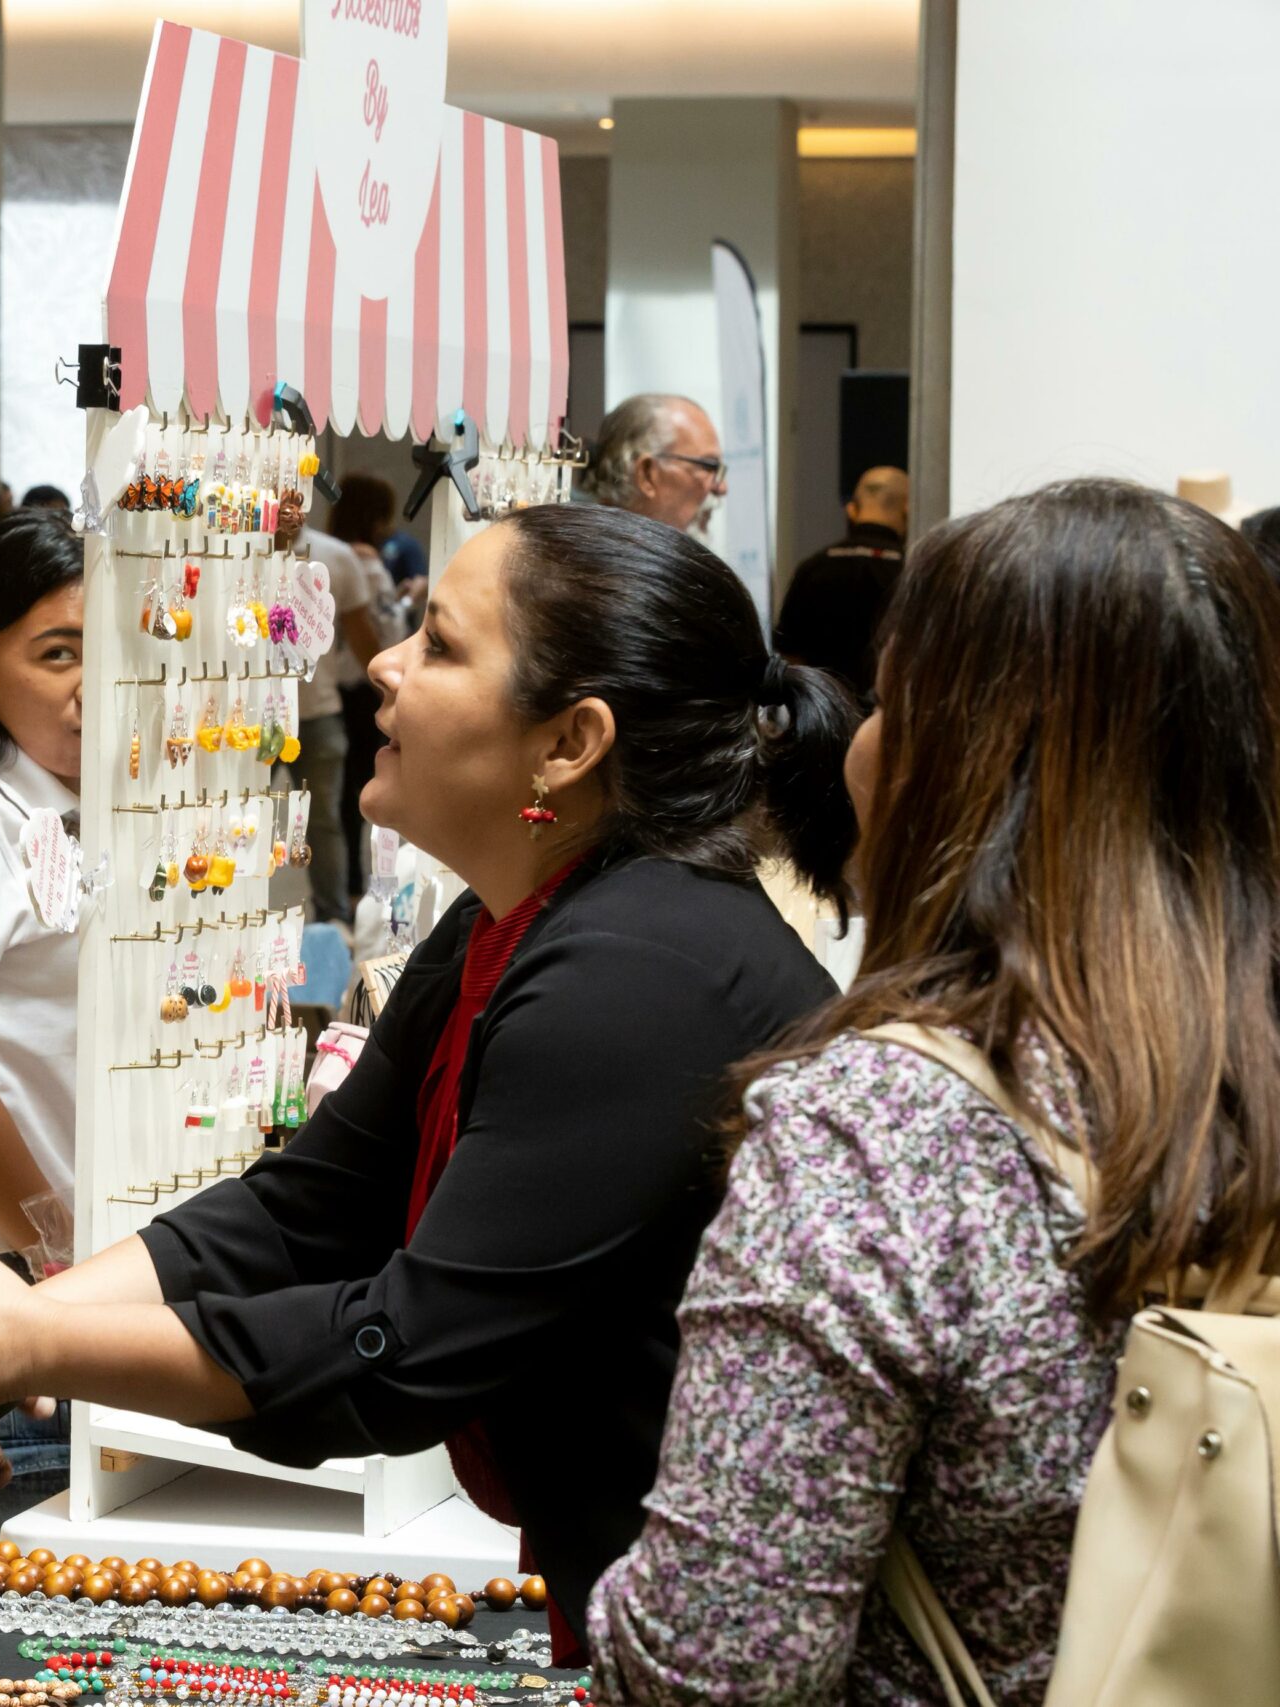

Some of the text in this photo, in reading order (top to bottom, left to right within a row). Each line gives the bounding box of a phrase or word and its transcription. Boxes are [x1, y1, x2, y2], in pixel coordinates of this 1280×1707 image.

[363, 58, 389, 143] By
[359, 158, 391, 227] Lea
[291, 595, 308, 619] retes
[307, 613, 316, 630] de
